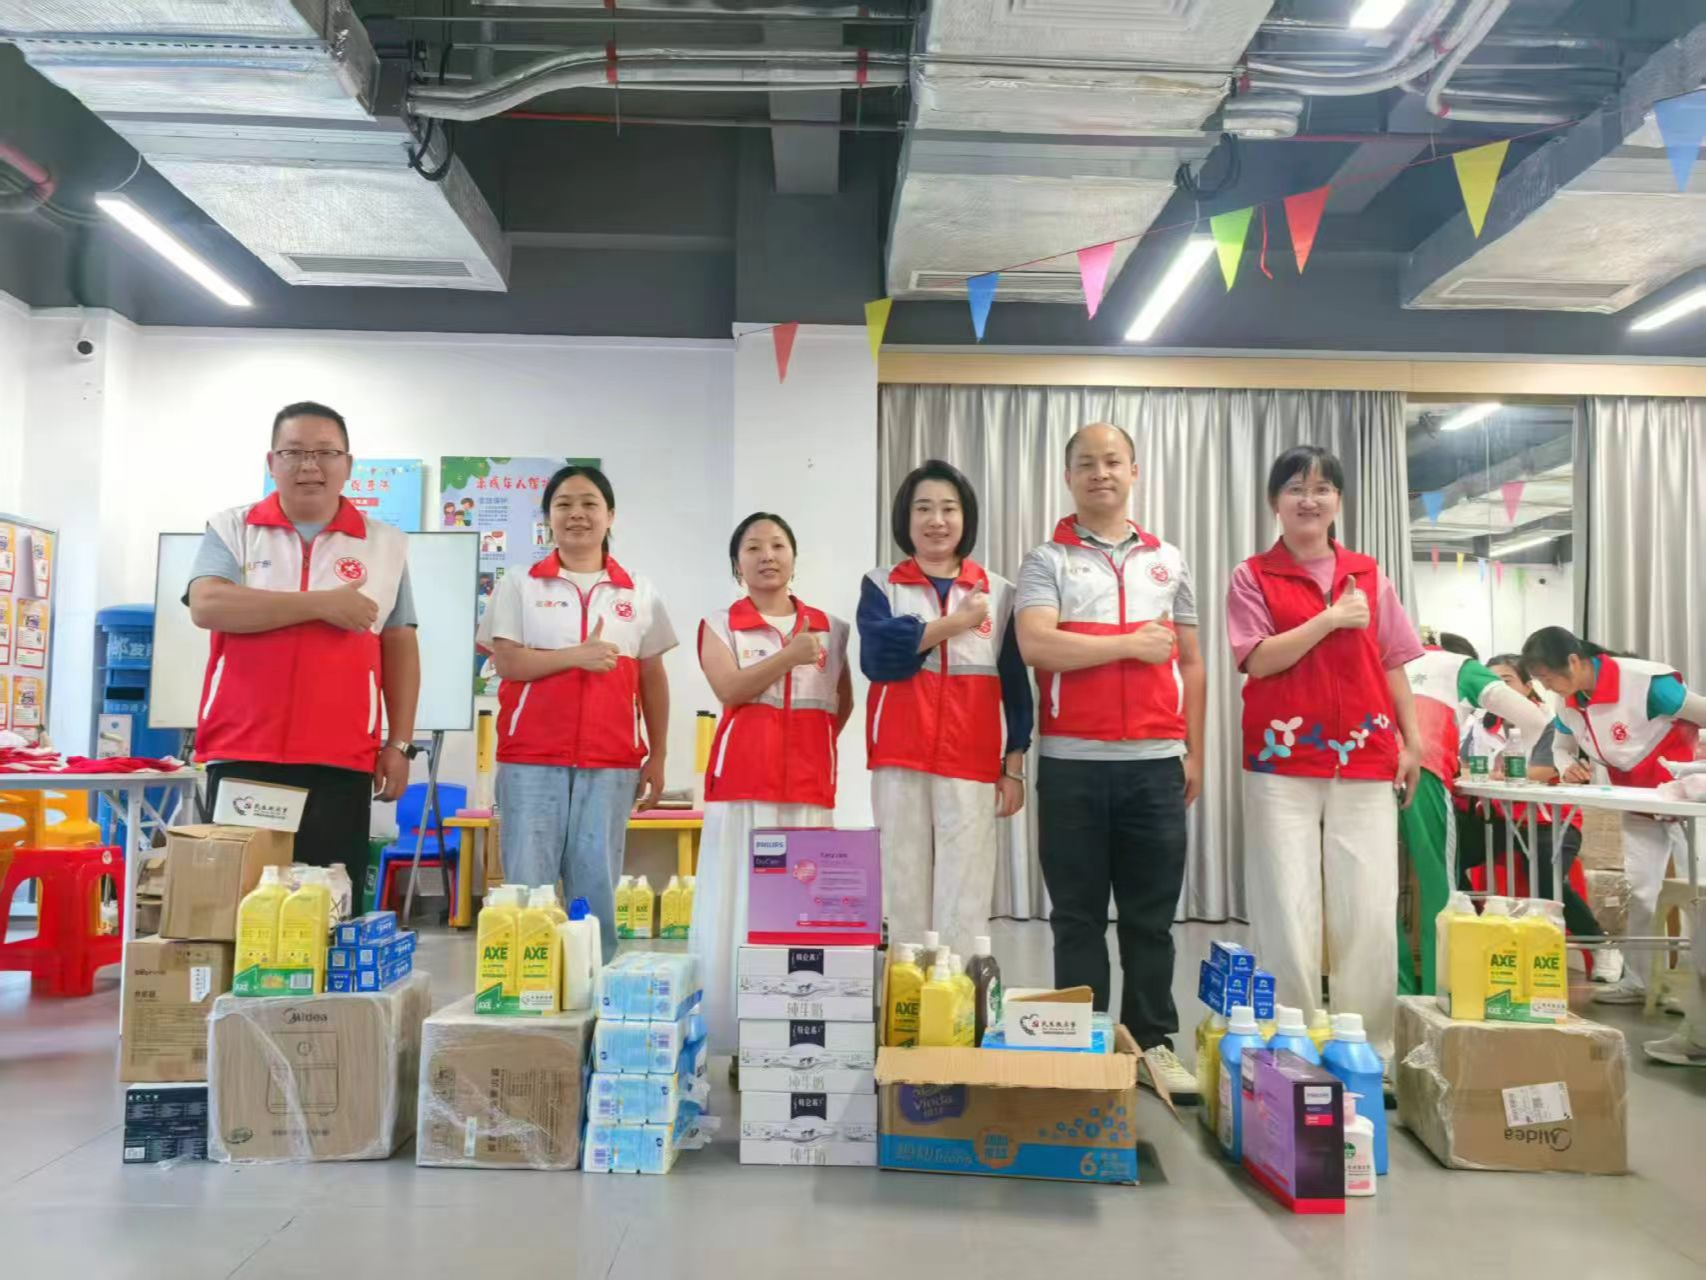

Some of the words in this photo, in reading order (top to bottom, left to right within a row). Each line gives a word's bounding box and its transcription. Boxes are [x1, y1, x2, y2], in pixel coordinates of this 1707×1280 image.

[756, 841, 784, 849] PHILIPS
[483, 946, 508, 960] AXE
[523, 946, 549, 960] AXE
[1490, 954, 1517, 968] AXE
[1533, 956, 1560, 970] AXE
[895, 1001, 919, 1015] AXE
[284, 1008, 328, 1024] Midea
[1504, 1128, 1572, 1152] Midea
[1079, 1151, 1097, 1177] 6
